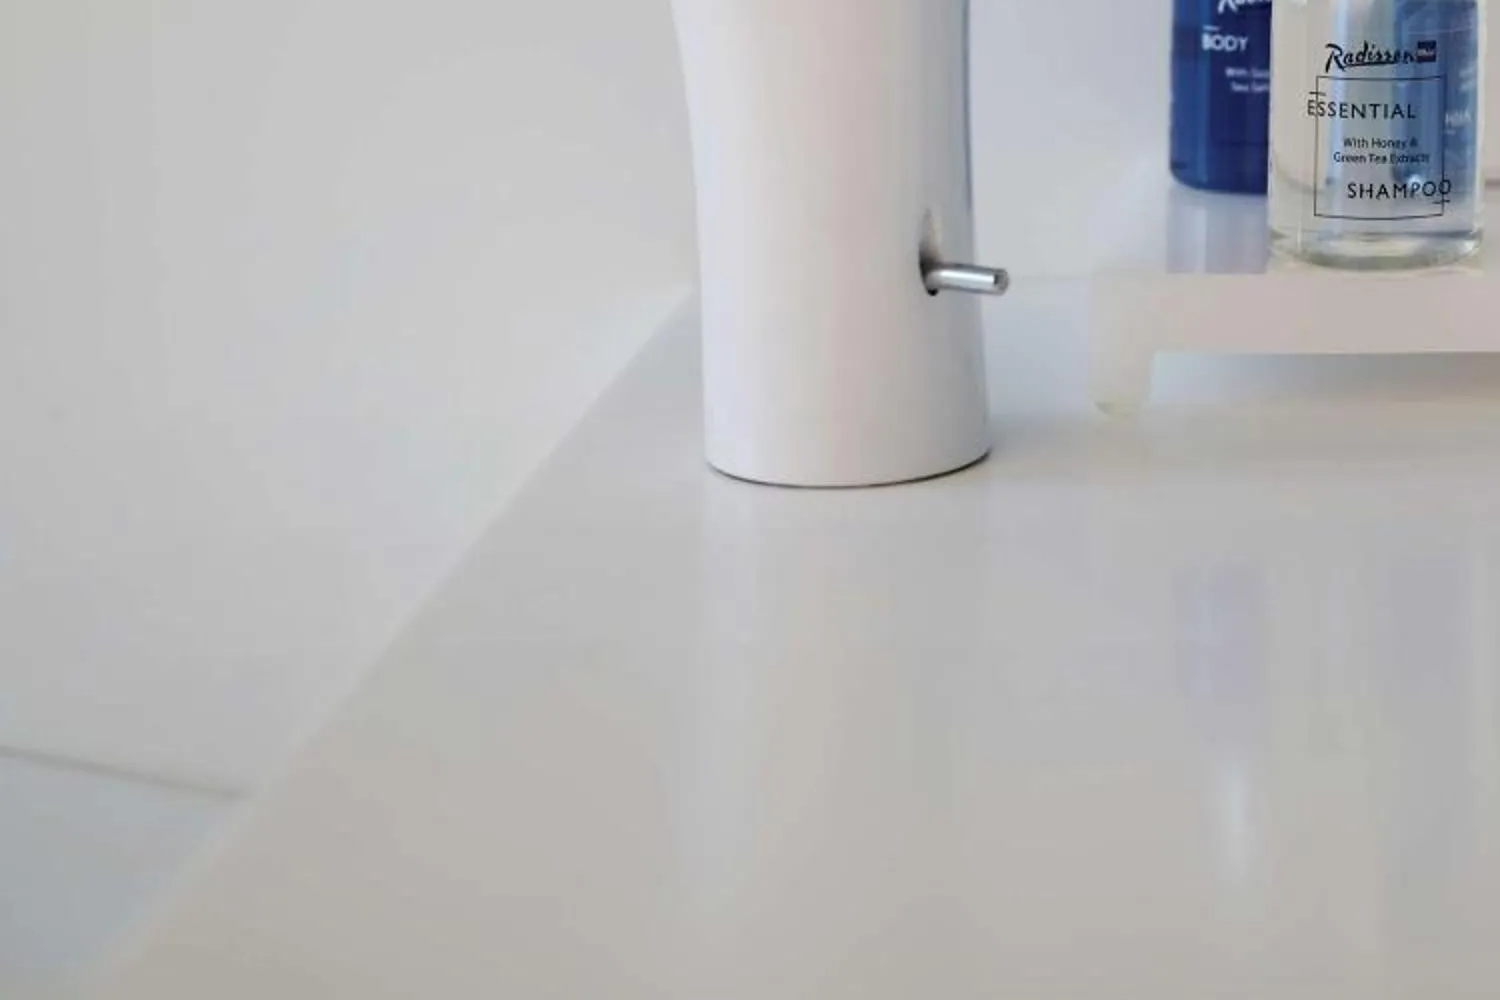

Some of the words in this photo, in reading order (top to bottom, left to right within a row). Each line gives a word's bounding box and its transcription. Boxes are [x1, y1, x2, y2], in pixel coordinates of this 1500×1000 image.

[1202, 33, 1248, 51] BODY
[1325, 40, 1414, 73] Radisson
[1307, 99, 1416, 120] ESSENTIAL
[1343, 136, 1369, 149] With
[1333, 151, 1367, 163] Green
[1347, 180, 1452, 200] SHAMPOO
